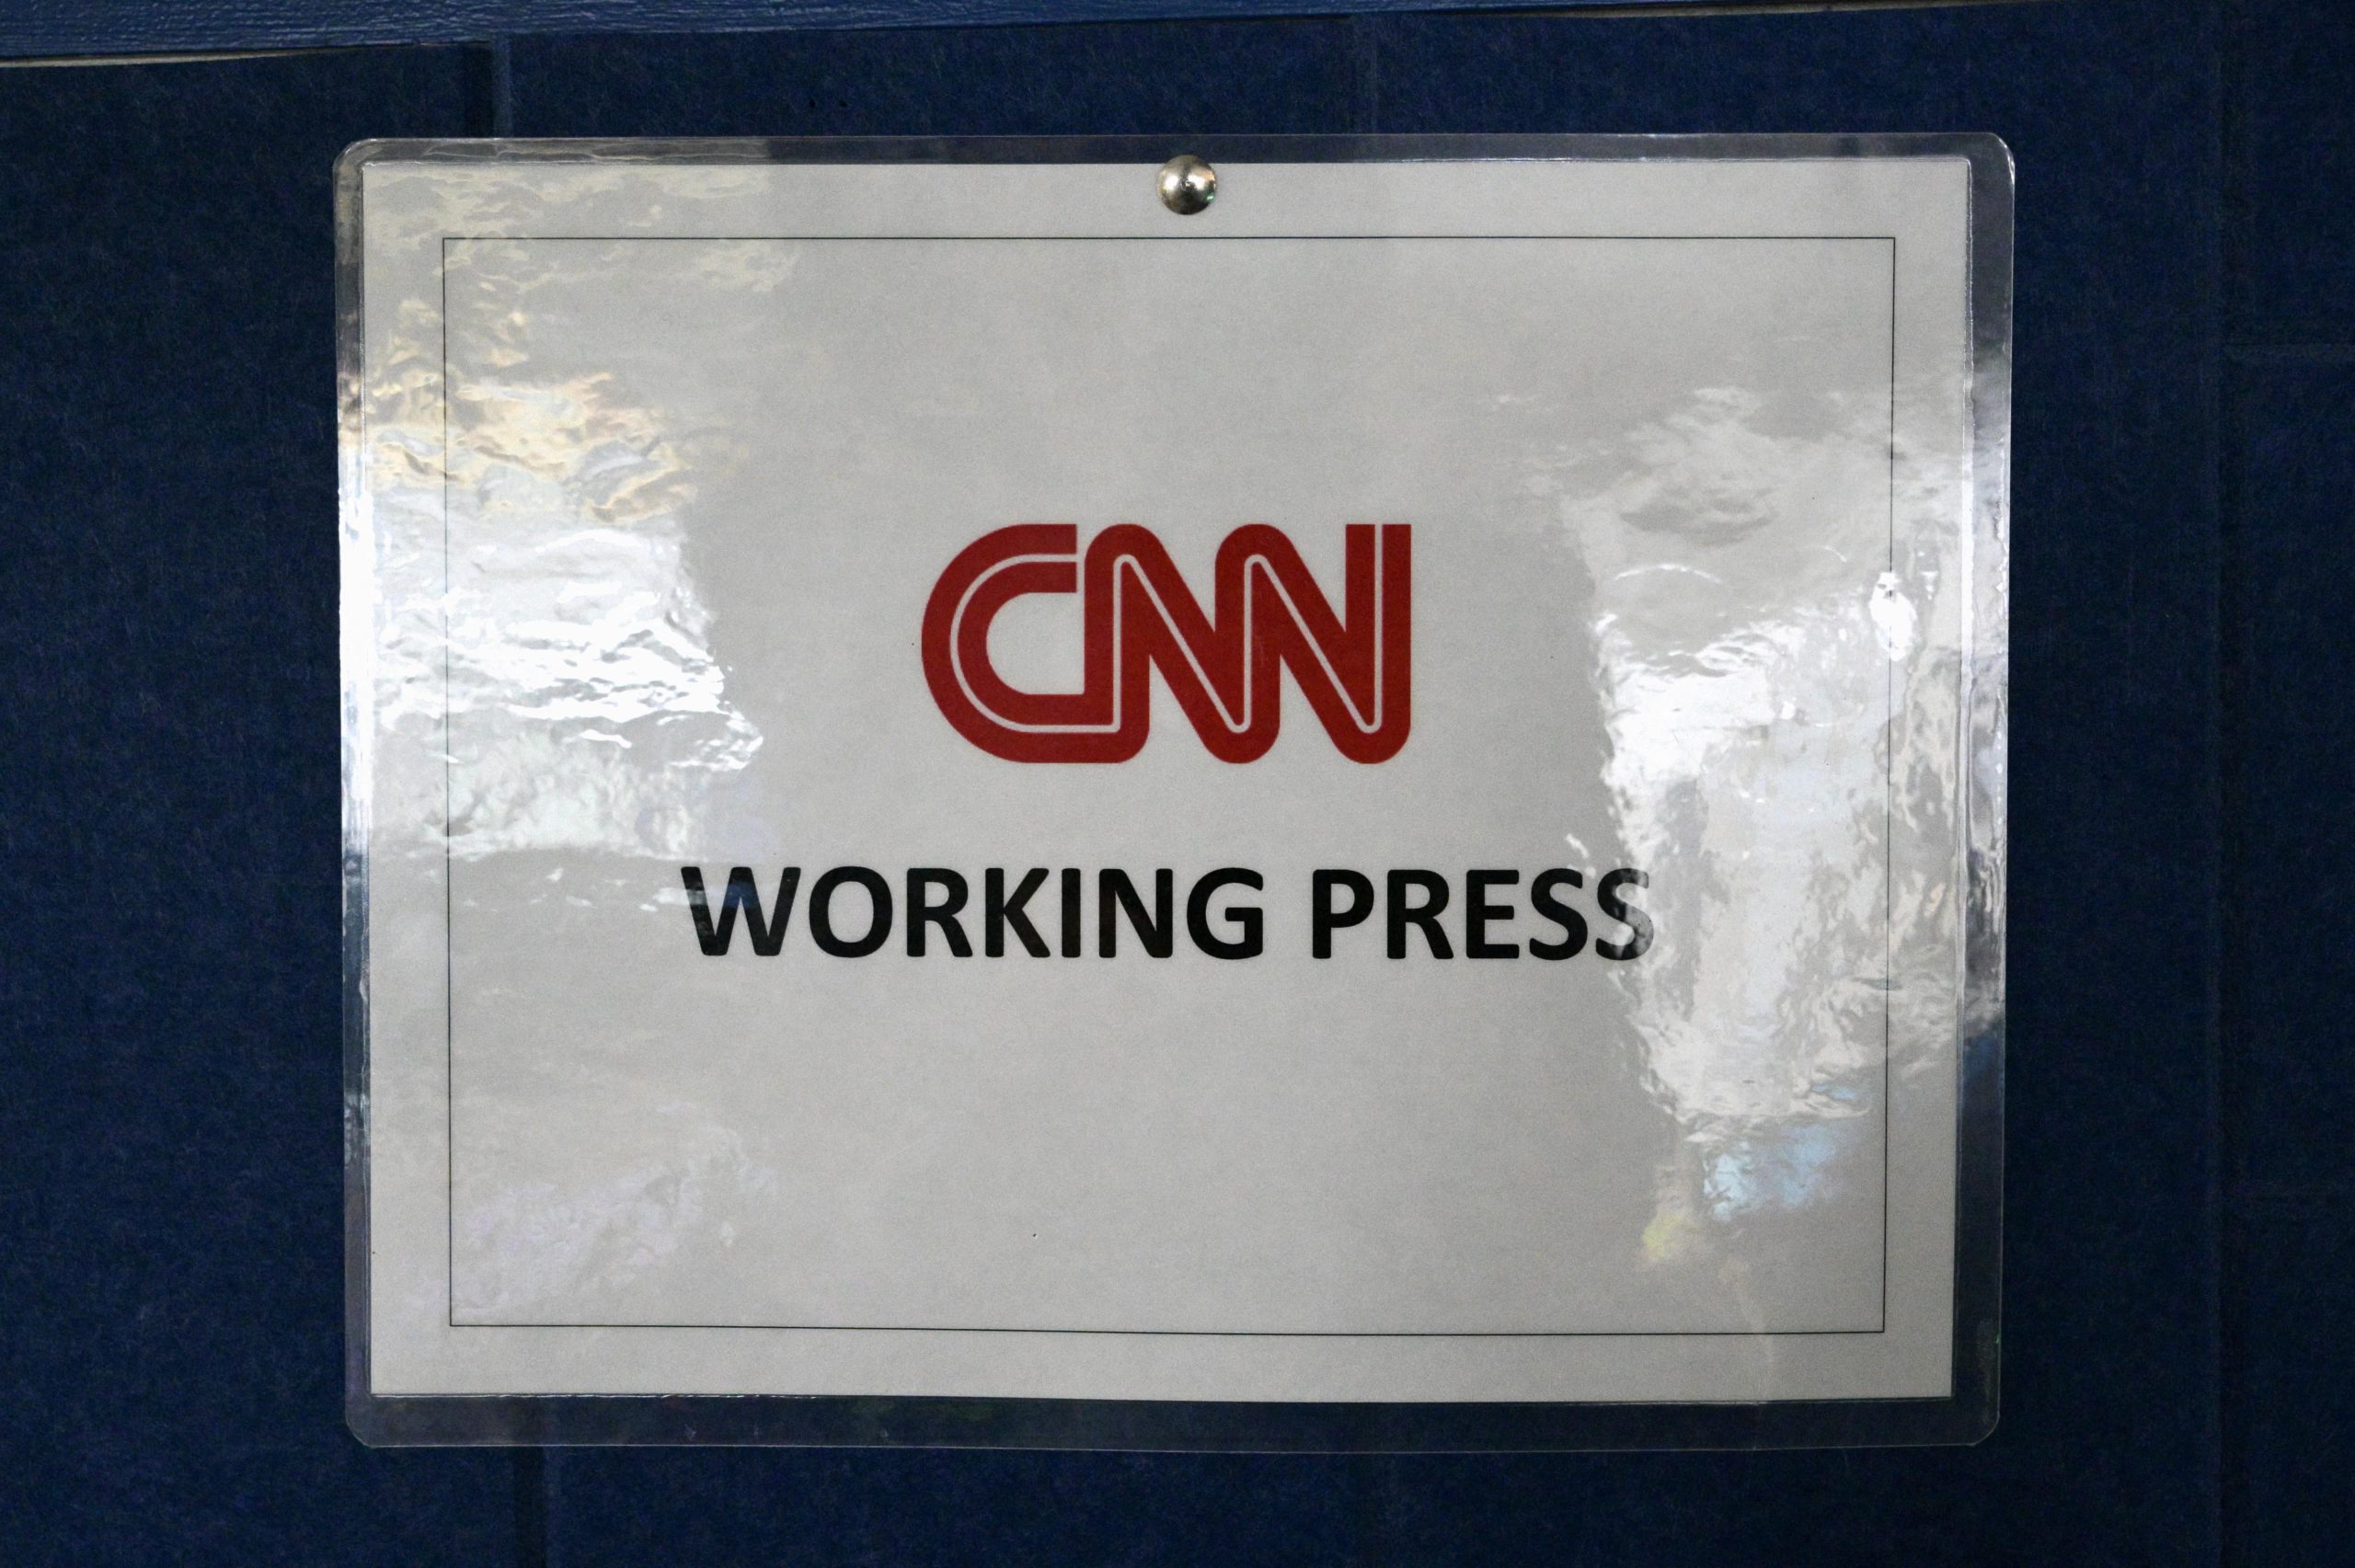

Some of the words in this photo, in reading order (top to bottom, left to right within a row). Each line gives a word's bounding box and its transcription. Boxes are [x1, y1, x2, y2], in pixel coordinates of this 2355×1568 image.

[922, 523, 1412, 763] CNN
[681, 866, 1265, 960] WORKING
[1312, 867, 1654, 961] PRESS
